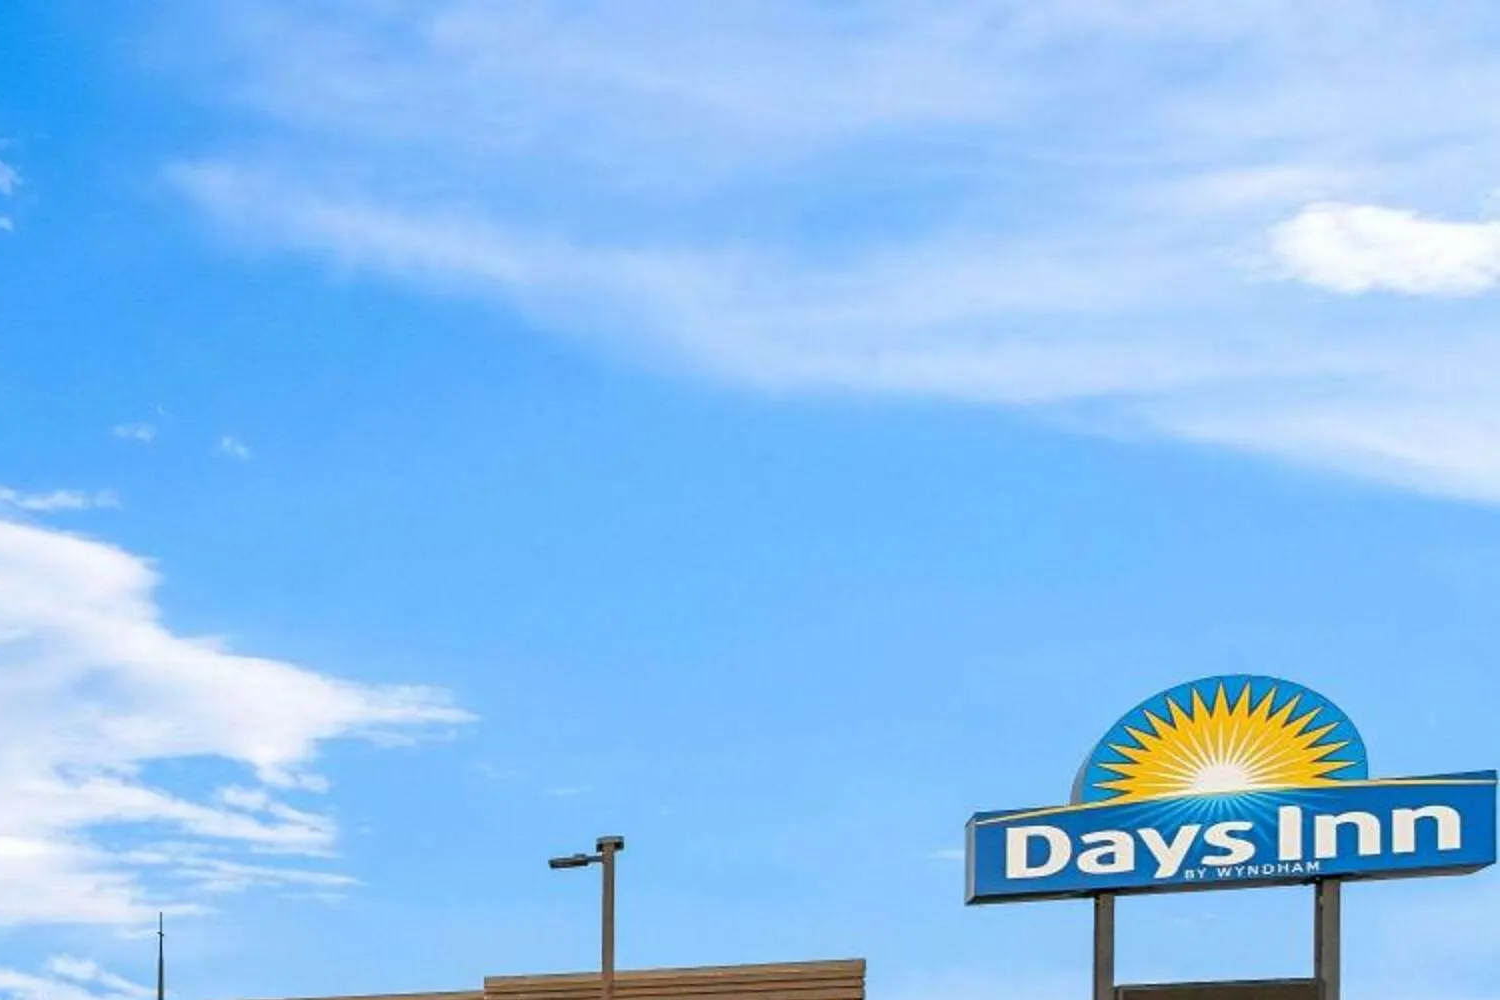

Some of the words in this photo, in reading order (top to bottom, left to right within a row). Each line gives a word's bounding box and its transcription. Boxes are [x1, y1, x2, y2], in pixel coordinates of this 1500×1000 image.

[1005, 819, 1256, 880] Days
[1277, 803, 1462, 862] Inn
[1184, 868, 1207, 879] BY
[1217, 861, 1320, 878] WYNDHAM
